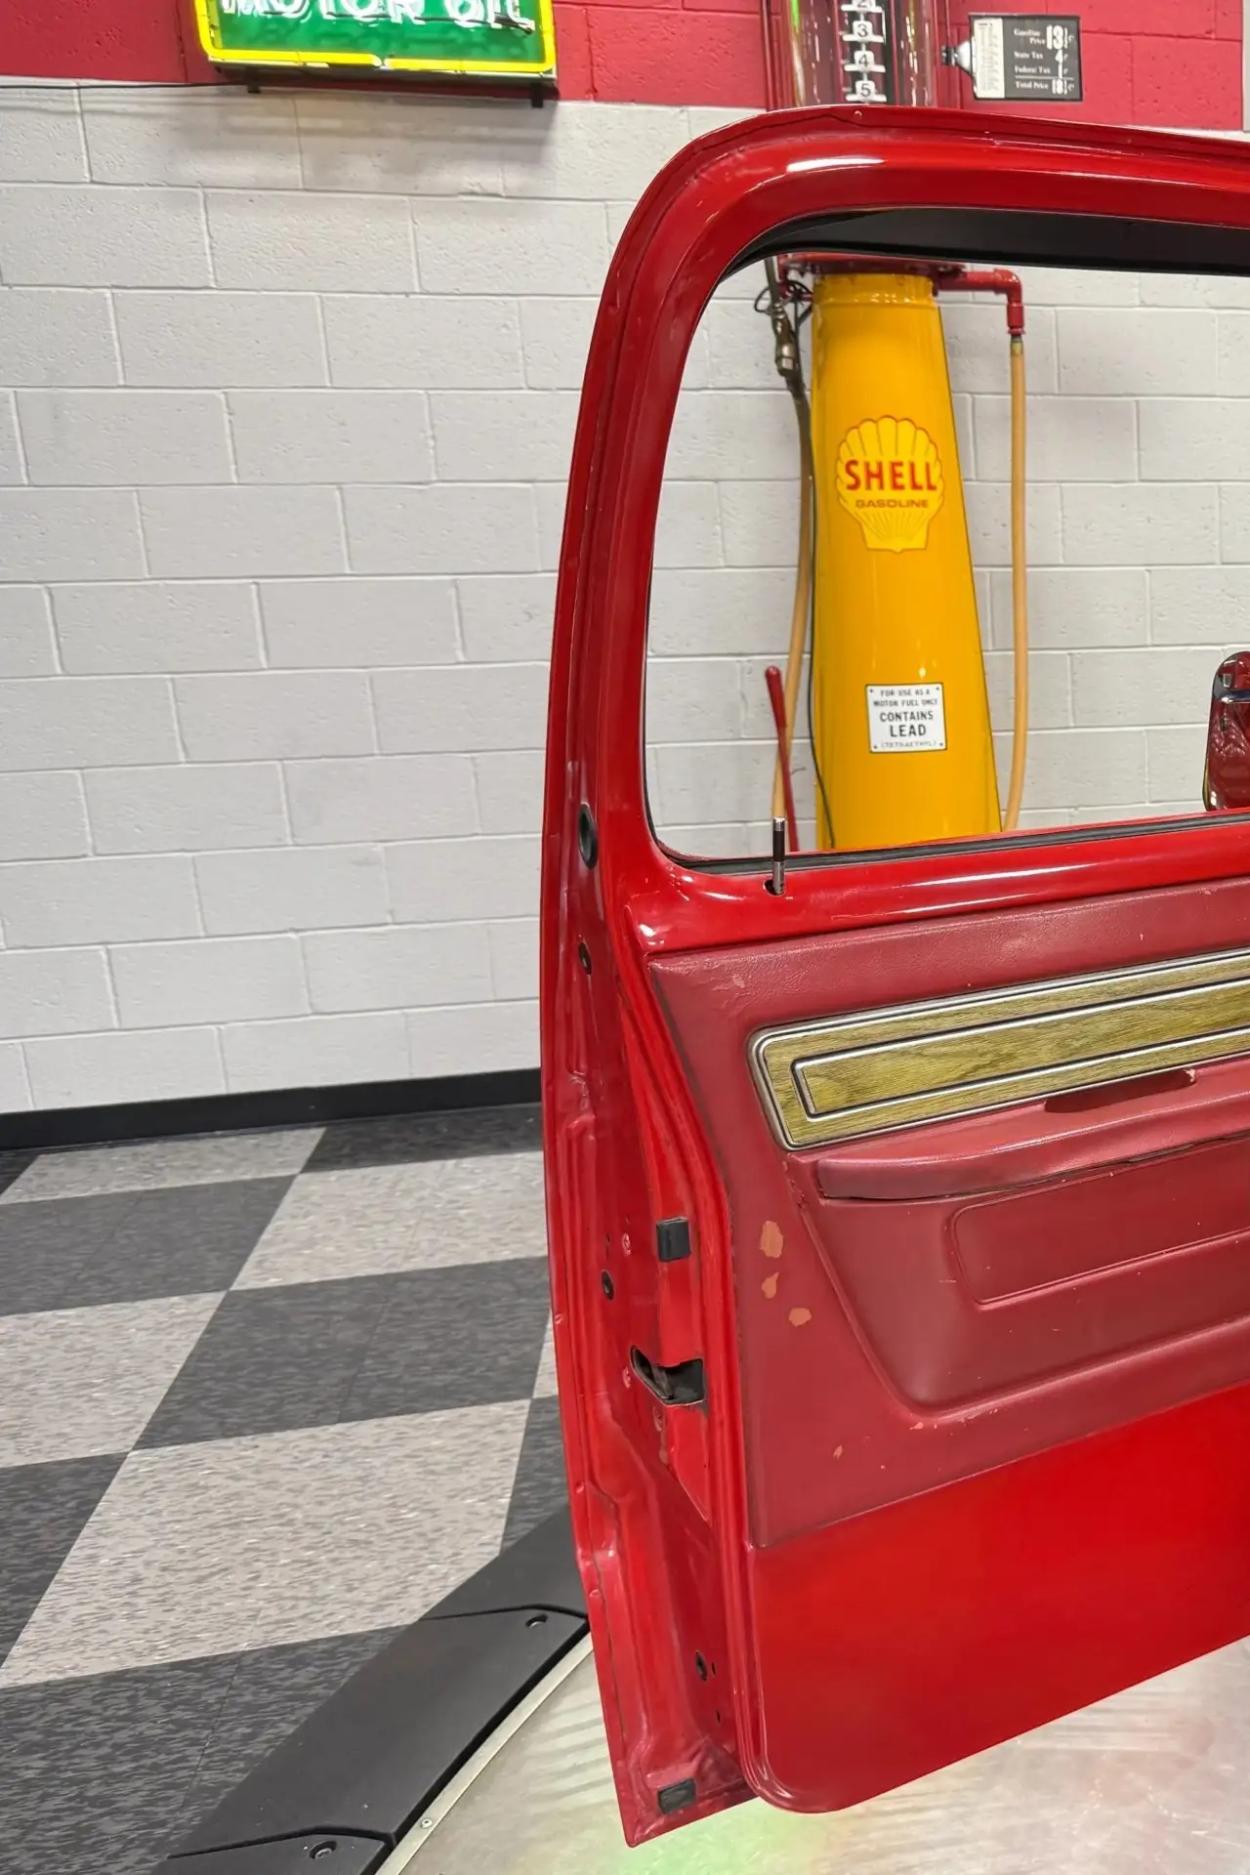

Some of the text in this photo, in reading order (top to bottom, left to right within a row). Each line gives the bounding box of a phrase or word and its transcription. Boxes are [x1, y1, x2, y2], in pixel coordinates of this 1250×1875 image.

[857, 23, 868, 38] 3
[858, 53, 869, 68] 4
[860, 83, 871, 97] 5
[844, 458, 937, 492] SHELL
[855, 498, 930, 510] GASOLINE
[880, 689, 895, 697] FOR
[915, 688, 924, 696] AS
[921, 698, 938, 706] ONLY
[879, 710, 934, 722] CONTAINS
[889, 724, 927, 738] LEAD
